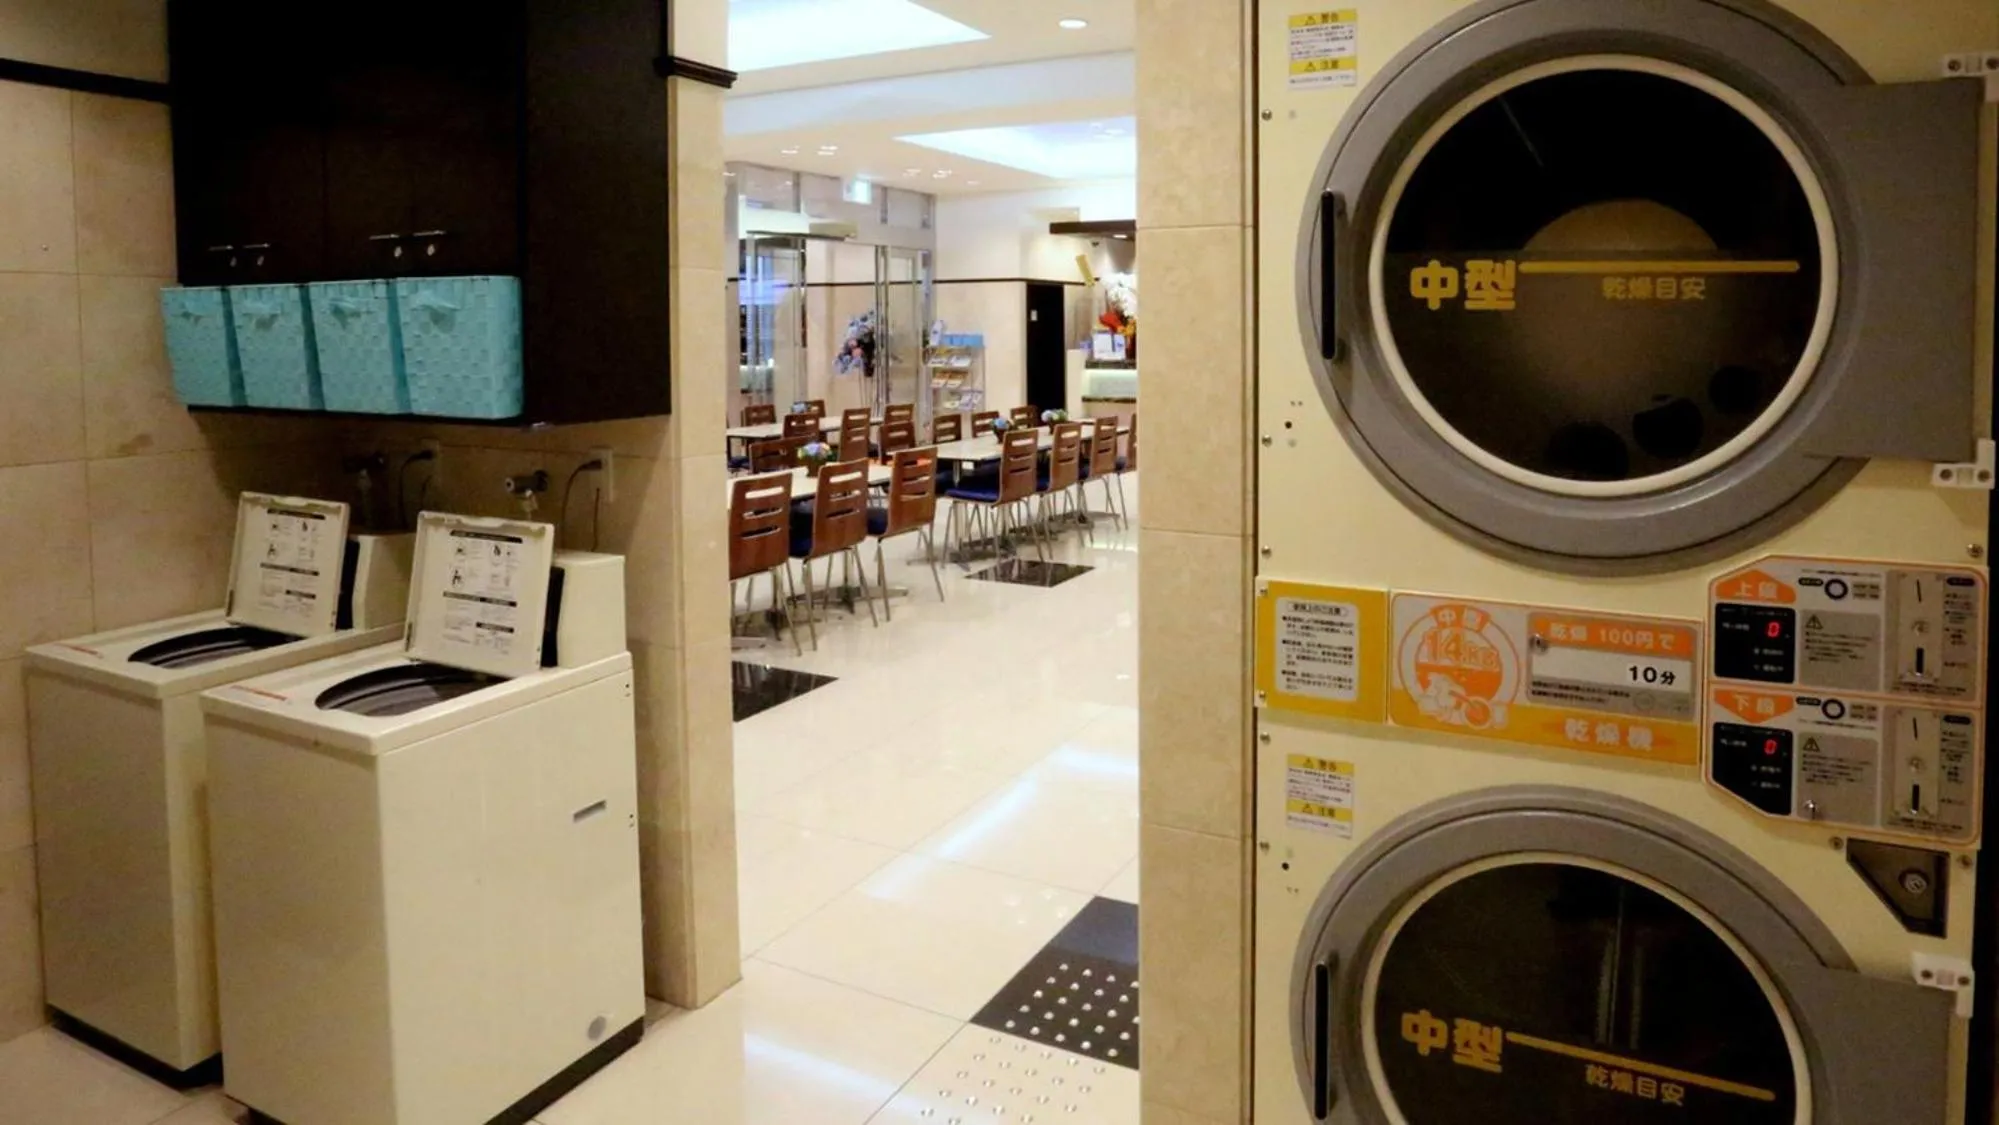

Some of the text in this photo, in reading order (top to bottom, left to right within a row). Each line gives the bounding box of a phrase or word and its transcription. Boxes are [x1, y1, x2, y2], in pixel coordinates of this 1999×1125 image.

[1410, 259, 1516, 310] 中型
[1602, 276, 1705, 300] 乾燥目安
[1601, 627, 1675, 649] 100円で
[1767, 621, 1780, 638] 0
[1629, 665, 1676, 686] 10分
[1764, 739, 1778, 755] 0
[1401, 1009, 1503, 1073] 中型
[1585, 1064, 1684, 1106] 乾燥目安
